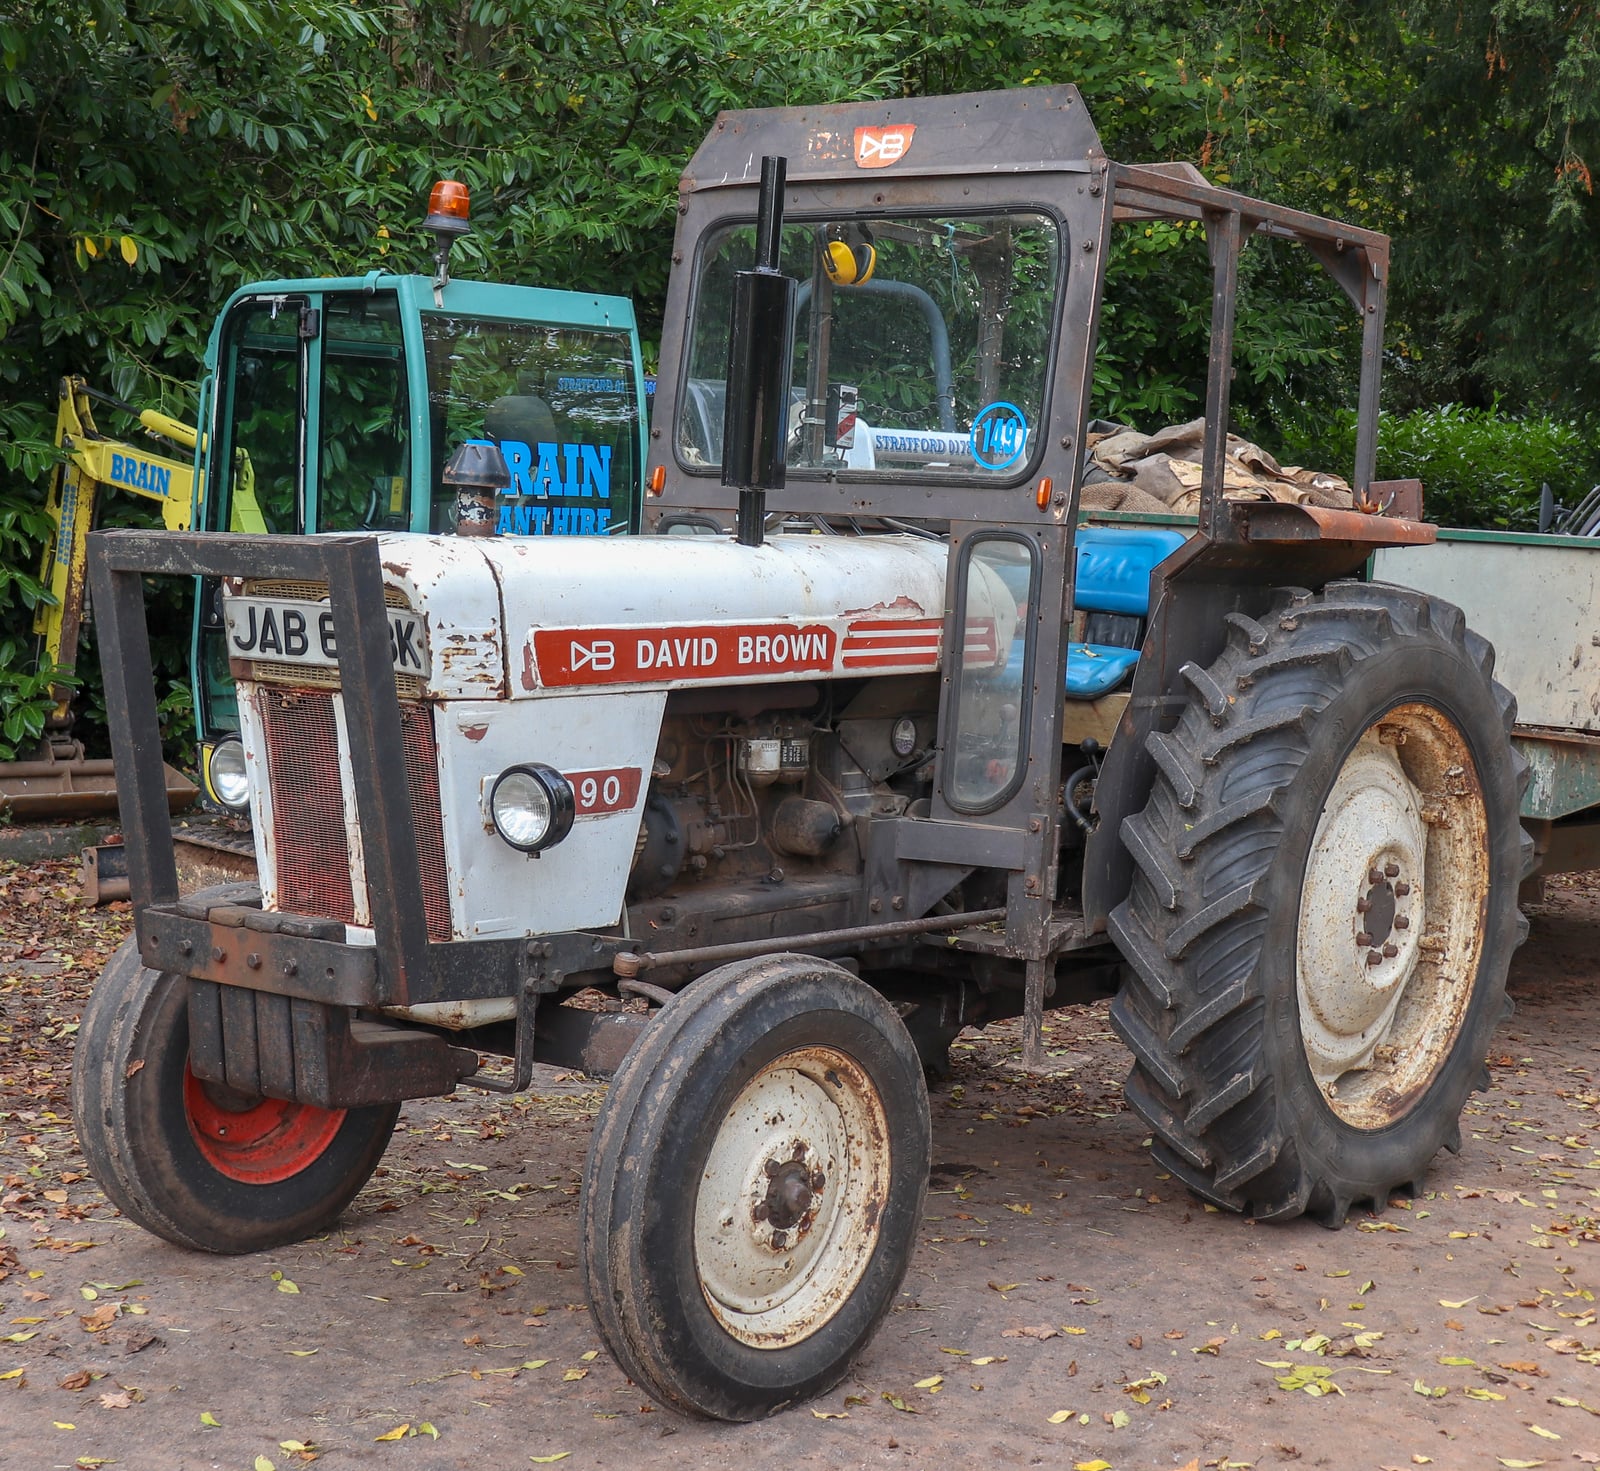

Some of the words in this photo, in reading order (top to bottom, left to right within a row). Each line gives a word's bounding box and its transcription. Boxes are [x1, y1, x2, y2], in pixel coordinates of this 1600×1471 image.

[875, 434, 946, 455] STRATFORD
[982, 417, 1017, 454] 149
[110, 453, 171, 496] BRAIN
[466, 439, 612, 499] RAIN
[494, 506, 548, 535] ANT
[233, 606, 309, 656] JAB
[637, 638, 718, 668] DAVID
[738, 633, 827, 664] BROWN
[568, 775, 621, 807] 90
